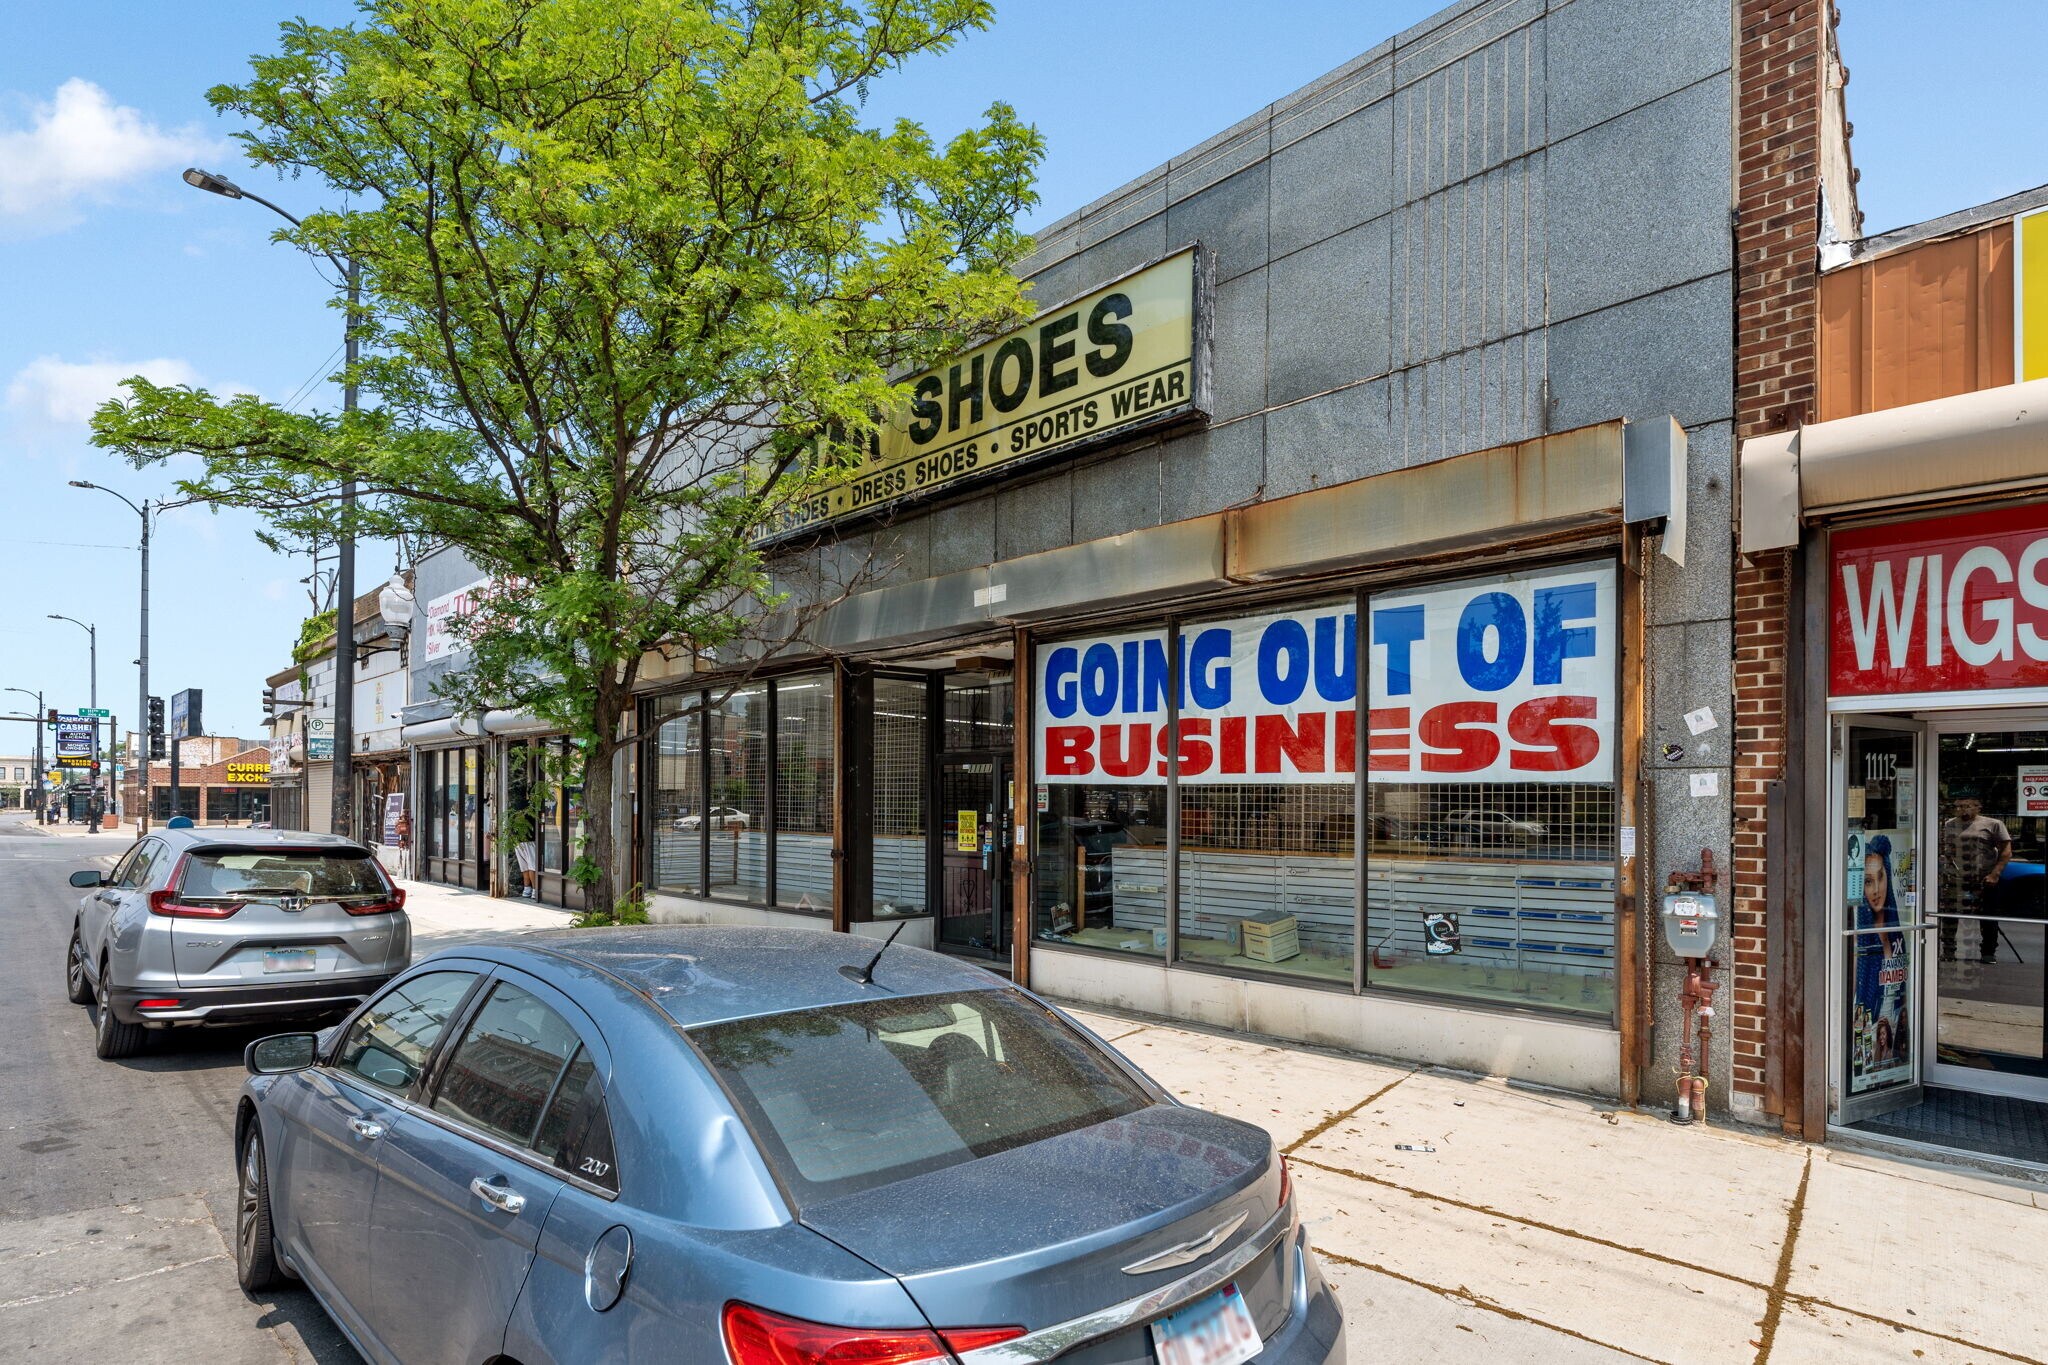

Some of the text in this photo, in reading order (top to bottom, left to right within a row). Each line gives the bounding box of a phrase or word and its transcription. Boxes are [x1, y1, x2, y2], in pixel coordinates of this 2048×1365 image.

[908, 292, 1134, 446] SHOES
[851, 468, 906, 507] DRESS
[914, 442, 978, 485] SHOES
[1010, 400, 1098, 453] SPORTS
[1110, 370, 1185, 420] WEAR
[427, 642, 440, 655] Silver
[1044, 581, 1598, 719] GOING OUT OF
[1044, 695, 1601, 777] BUSINESS
[1865, 752, 1898, 781] 11113
[1891, 938, 1904, 957] 2X
[1879, 967, 1909, 986] MAMBO
[579, 1156, 610, 1177] 200
